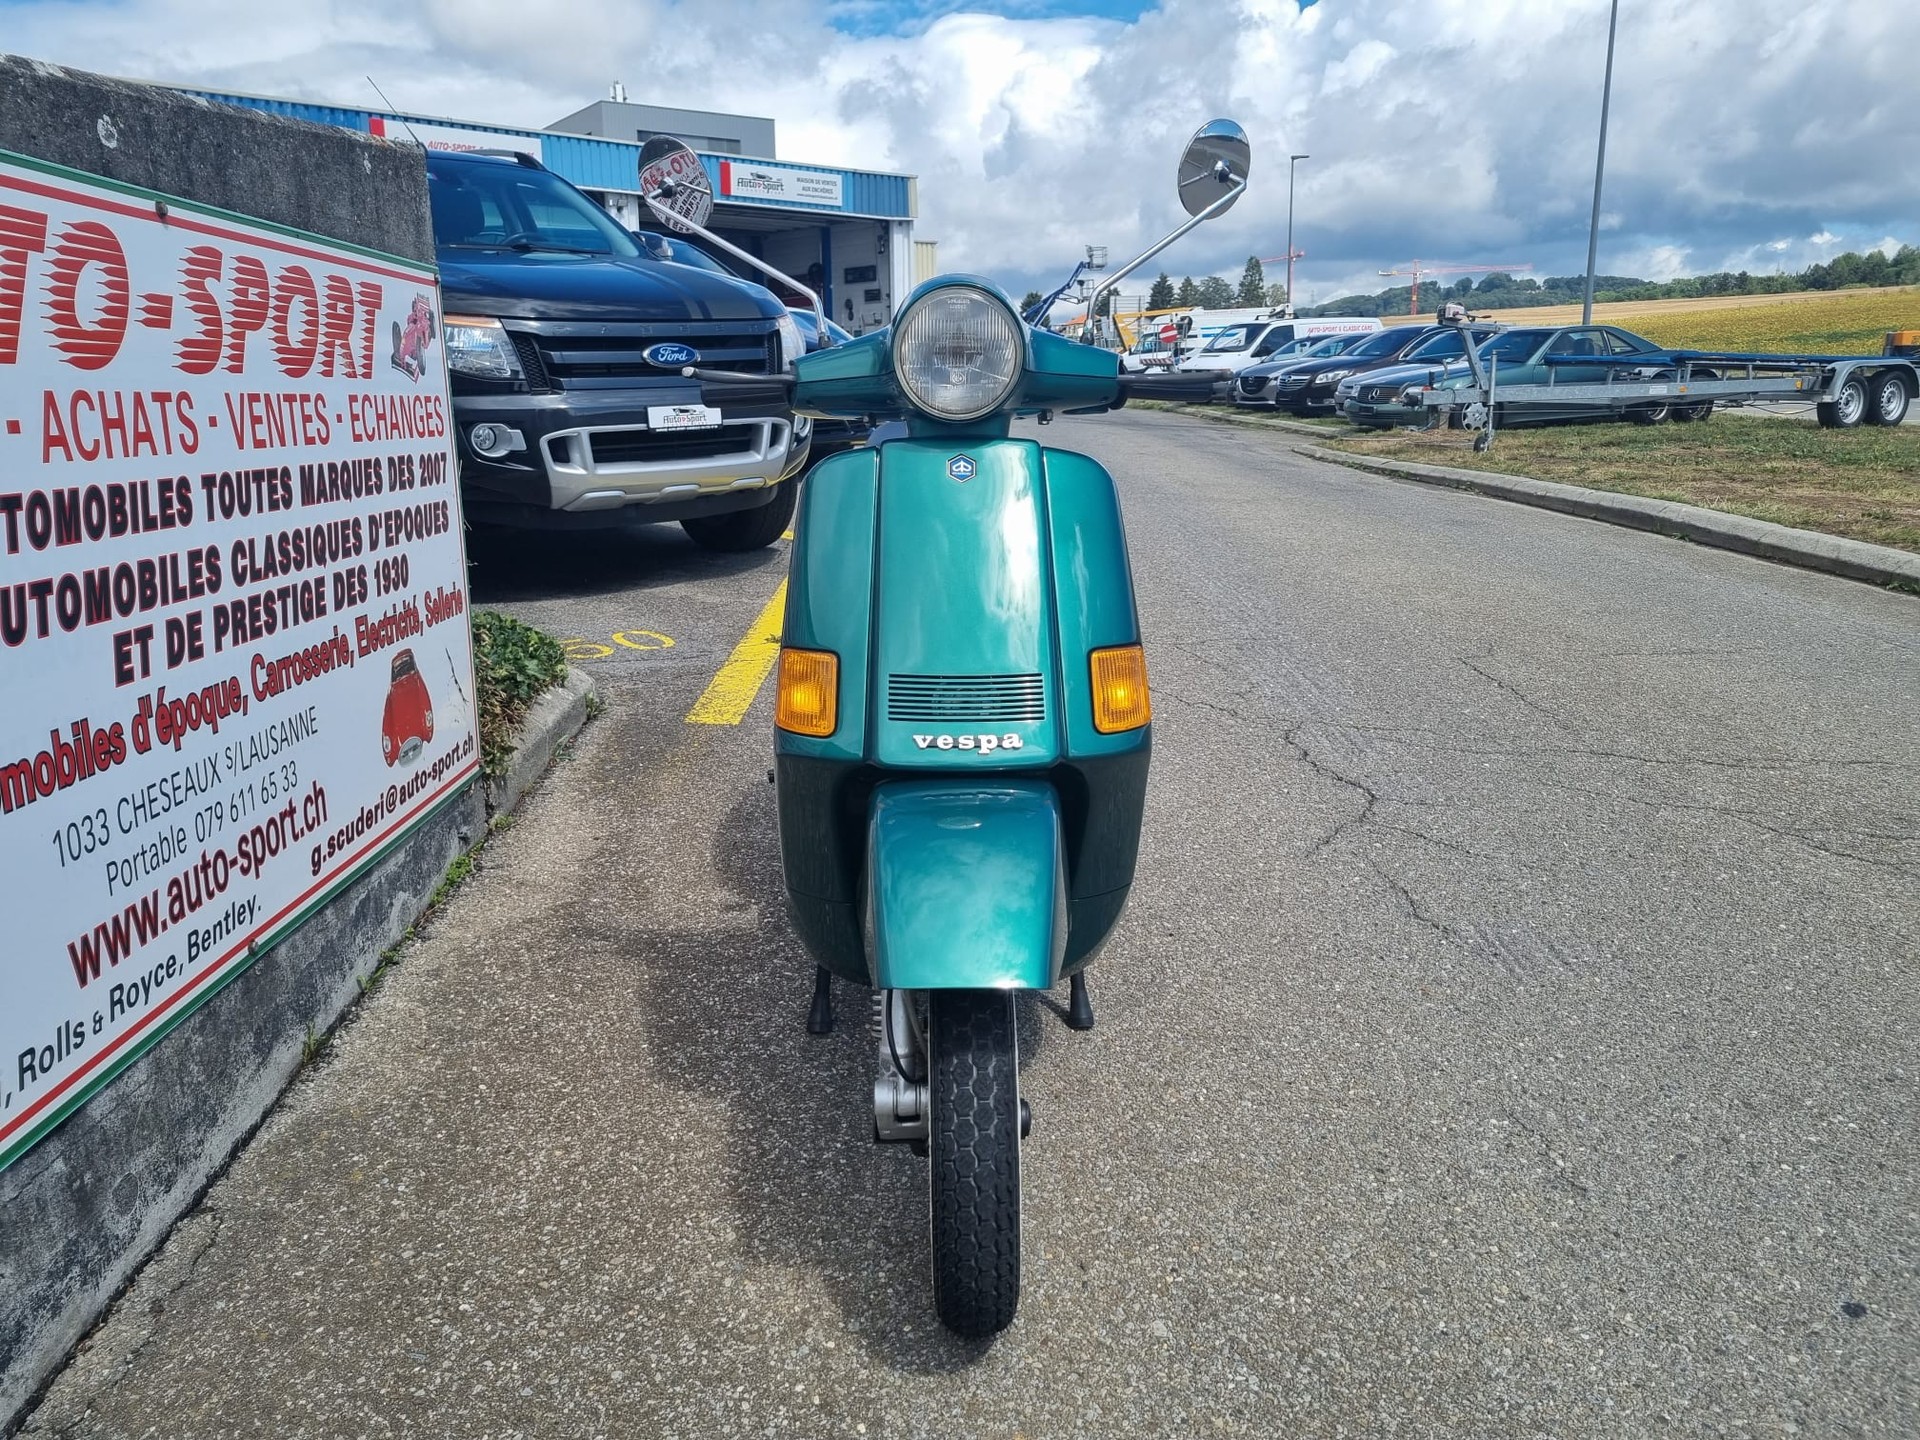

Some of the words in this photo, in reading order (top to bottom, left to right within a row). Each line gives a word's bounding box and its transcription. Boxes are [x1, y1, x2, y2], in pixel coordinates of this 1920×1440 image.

[657, 346, 688, 362] Ford
[42, 389, 200, 463] ACHATS
[225, 392, 331, 451] VENTES
[347, 393, 446, 443] ECHANGES
[0, 475, 194, 555] TOMOBILES
[201, 468, 293, 523] TOUTES
[300, 456, 383, 508] MARQUES
[388, 454, 415, 493] DES
[419, 452, 448, 486] 2007
[0, 544, 222, 648] UTOMOBILES
[230, 516, 363, 589] CLASSIQUES
[368, 499, 449, 553] D'EPOQUES
[112, 624, 154, 688] ET
[167, 610, 205, 671] DE
[213, 579, 328, 656] PRESTIGE
[333, 567, 370, 611] DES
[374, 553, 410, 597] 1930
[0, 718, 127, 815] mobiles
[131, 675, 250, 757] d'époque,
[250, 626, 355, 703] Carrosserie,
[424, 581, 464, 628] Sellerie
[912, 733, 1023, 755] vespa
[52, 807, 110, 868] 1033
[117, 752, 222, 836] CHESEAUX
[106, 827, 188, 897] Portable
[194, 806, 225, 845] 079
[229, 785, 256, 825] 611
[260, 771, 278, 804] 65
[281, 760, 298, 792] 33
[310, 730, 475, 875] g.scuderi@auto-sport.ch
[67, 779, 329, 990] www.auto-sport.ch
[17, 1019, 86, 1093] Rolls
[92, 1008, 103, 1033] &
[108, 956, 184, 1024] Royce,
[187, 893, 262, 964] Bentley.
